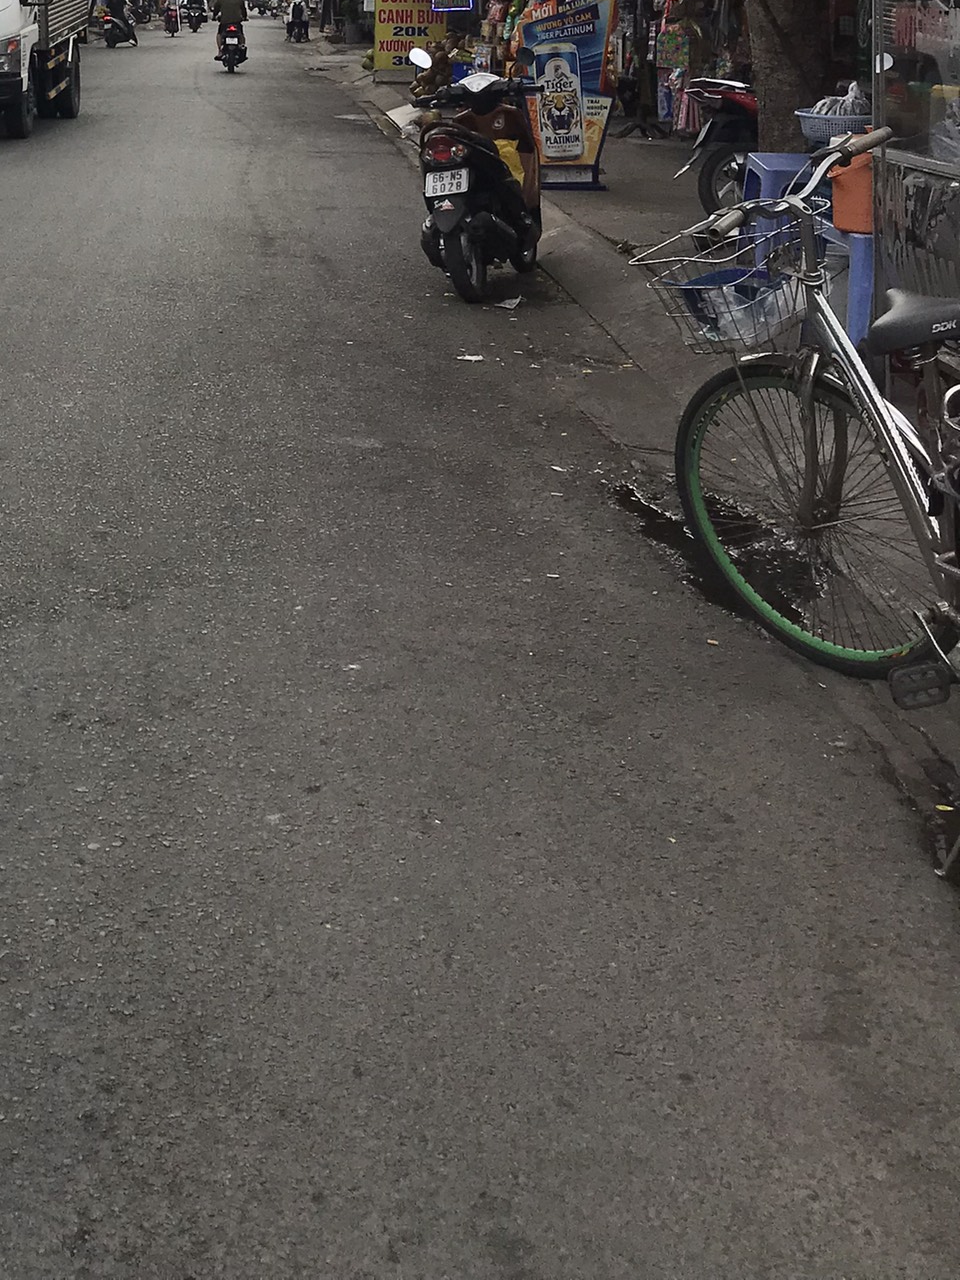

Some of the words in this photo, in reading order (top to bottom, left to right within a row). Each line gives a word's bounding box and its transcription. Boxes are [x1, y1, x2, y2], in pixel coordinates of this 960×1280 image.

[378, 9, 413, 24] CANH
[532, 4, 553, 20] MỚI
[393, 26, 429, 37] 20K
[537, 31, 554, 40] TIGER
[555, 23, 593, 37] PLATINUM
[379, 39, 415, 52] XƯƠNG
[545, 78, 573, 93] Tiger
[545, 135, 581, 145] PLATINUM
